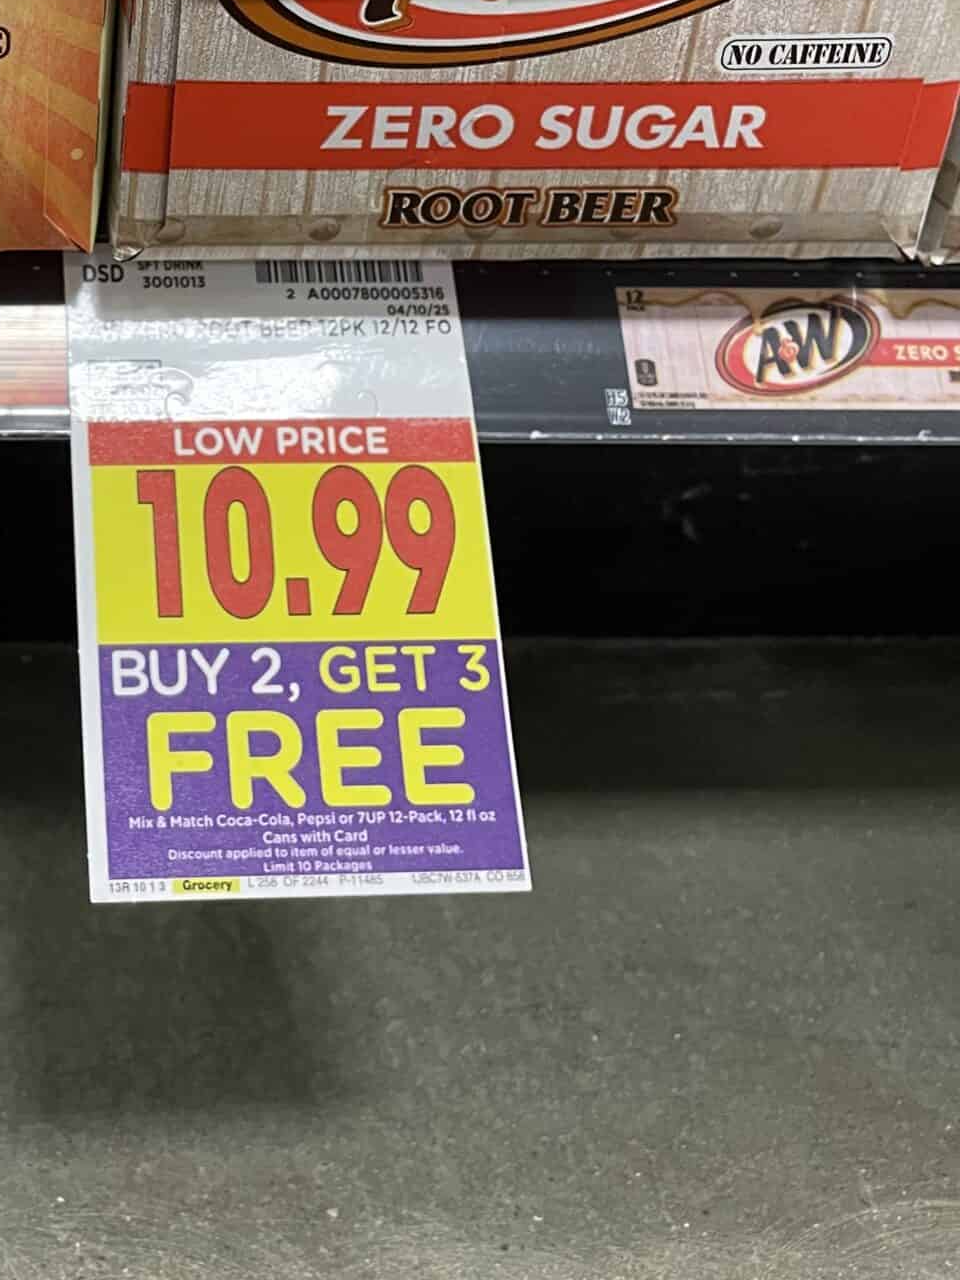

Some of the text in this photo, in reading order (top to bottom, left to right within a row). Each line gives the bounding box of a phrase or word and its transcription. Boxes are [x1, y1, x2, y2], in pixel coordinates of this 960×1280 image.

[726, 40, 885, 65] NO CAFFEINE
[320, 104, 766, 150] ZERO SUGAR
[387, 190, 676, 227] ROOT BEER
[82, 263, 124, 283] DSD
[163, 260, 203, 271] DRINK
[143, 276, 206, 289] 3001013
[285, 288, 296, 300] 2
[387, 304, 450, 316] 04/10/25
[321, 320, 366, 337] 12PK
[374, 319, 419, 337] 12/12
[426, 320, 452, 336] FO
[894, 344, 949, 361] ZERO
[173, 425, 388, 456] LOW PRICE
[136, 464, 456, 620] 10.99
[111, 643, 491, 703] BUY 2, GET 3
[146, 706, 475, 811] FREE
[128, 809, 497, 829] Mix & Match Coca-Cola, Pepsi or 7UP 12-Pack, 12 fl oz
[262, 829, 368, 844] Cans with Card
[168, 844, 464, 861] Discount applied to item of equal or lesser value.
[263, 860, 373, 873] Limit 10 Packages
[182, 879, 232, 892] Grocery
